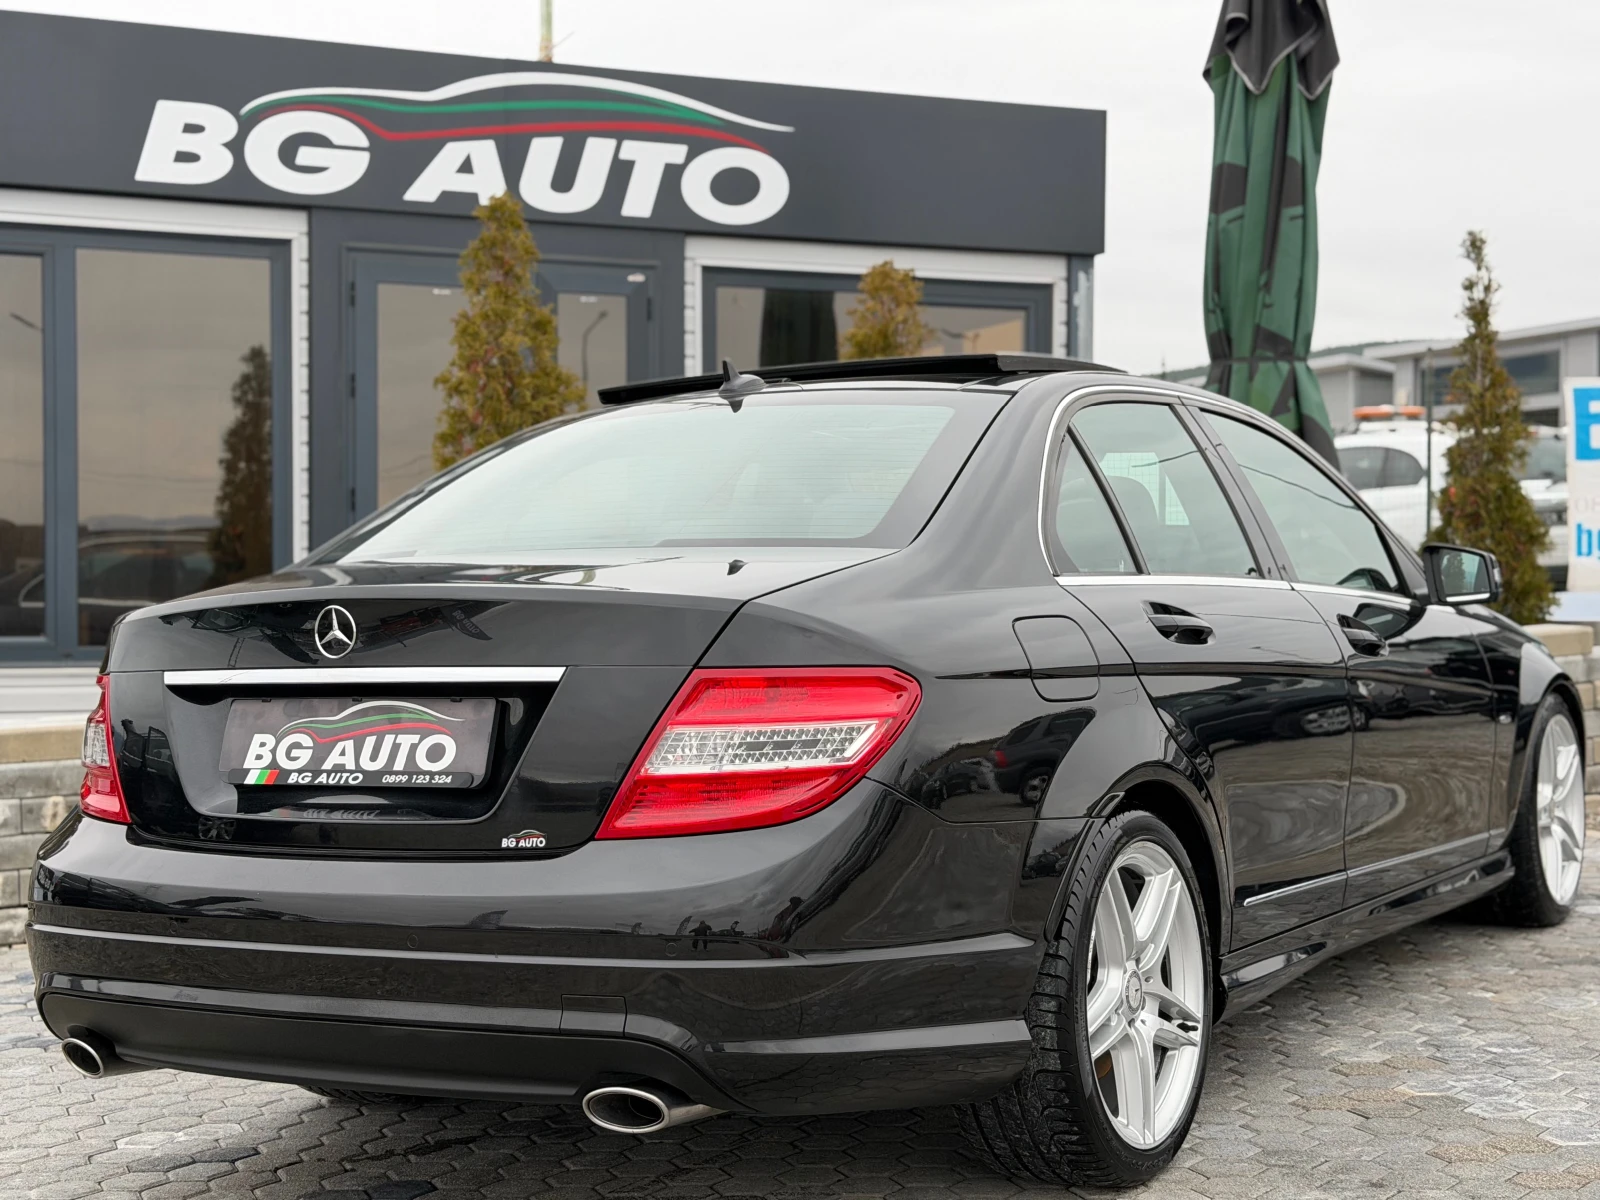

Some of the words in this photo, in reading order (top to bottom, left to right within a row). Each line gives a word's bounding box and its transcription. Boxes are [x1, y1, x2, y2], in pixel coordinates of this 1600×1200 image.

[134, 99, 370, 195] BG
[402, 136, 790, 225] AUTO
[242, 733, 314, 770] BG
[320, 733, 457, 772] AUTO
[287, 772, 312, 783] BG
[314, 772, 363, 784] AUTO
[381, 774, 409, 783] 0899
[411, 774, 431, 783] 123
[431, 774, 453, 784] 324
[501, 838, 516, 847] BG
[518, 837, 546, 847] AUTO
